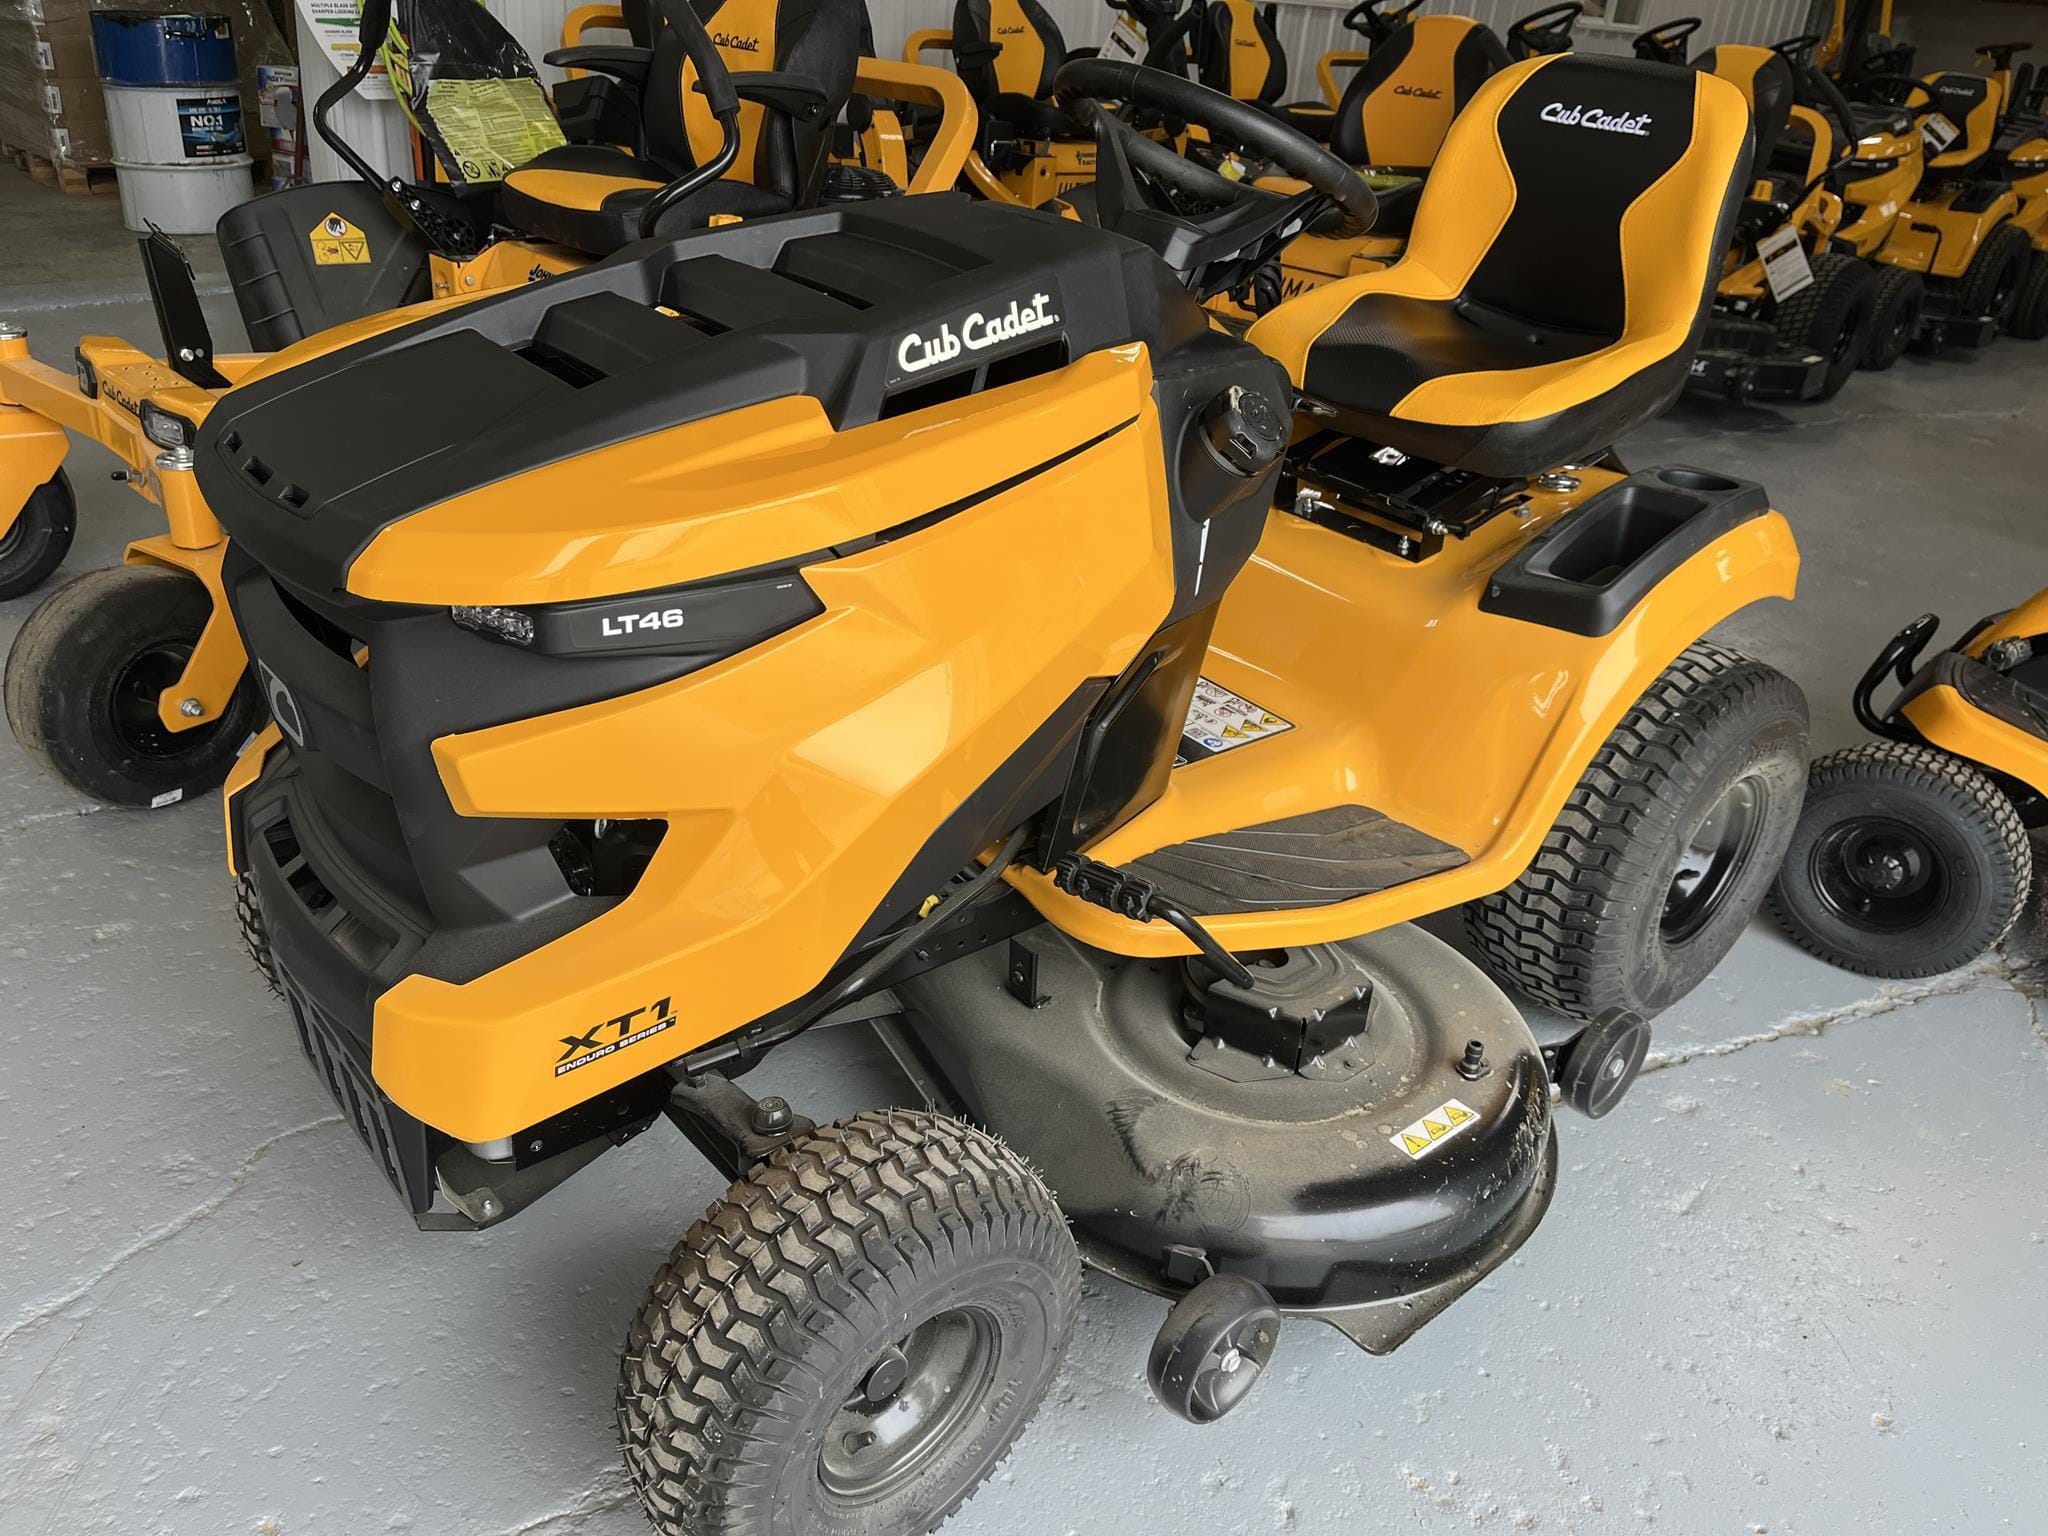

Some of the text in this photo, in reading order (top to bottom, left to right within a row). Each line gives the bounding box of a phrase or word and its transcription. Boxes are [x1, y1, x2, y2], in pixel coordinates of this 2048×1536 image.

[713, 32, 760, 52] Cub Cadet
[1540, 102, 1653, 136] Cub Cadet
[898, 292, 1054, 373] Cub Cadet
[102, 380, 140, 418] Cub Cadet
[602, 608, 684, 637] LT46
[556, 996, 671, 1063] XT1
[557, 1021, 667, 1075] ENDURO SERIES
